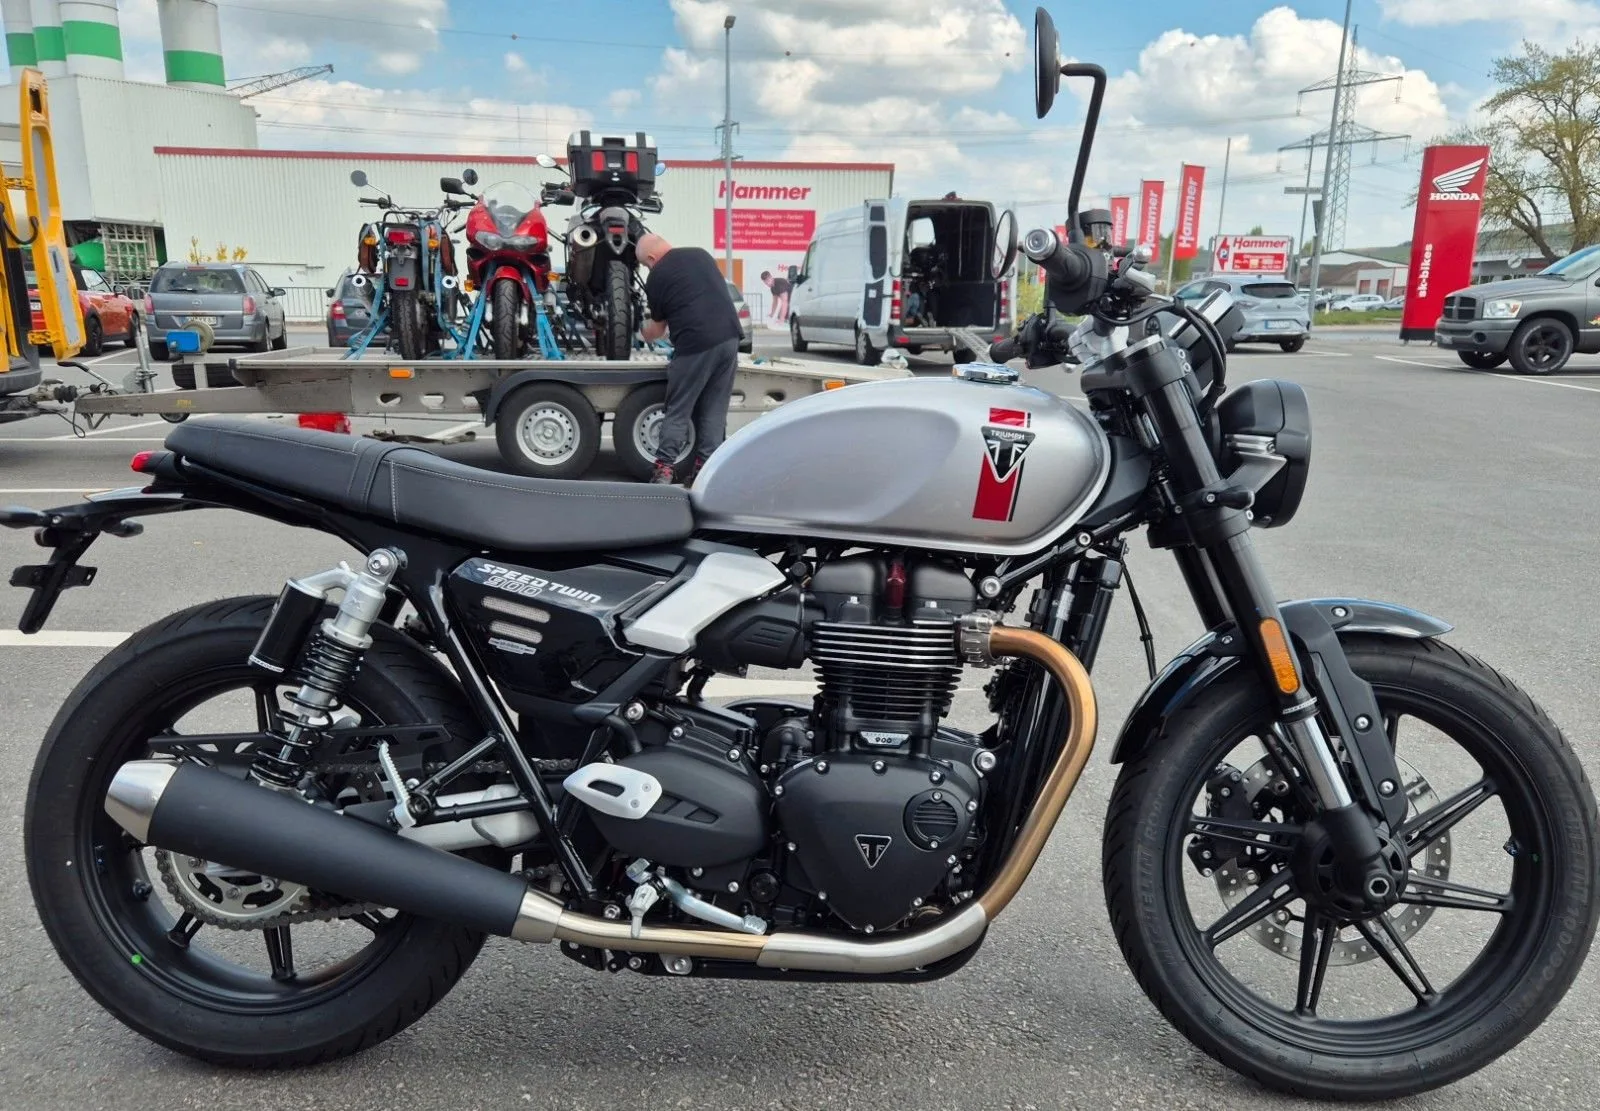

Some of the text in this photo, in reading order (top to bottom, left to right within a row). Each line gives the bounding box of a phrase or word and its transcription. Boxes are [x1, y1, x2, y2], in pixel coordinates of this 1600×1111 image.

[718, 180, 811, 202] Hammer
[1429, 192, 1481, 201] HONDA
[1178, 177, 1199, 249] Hammer
[1232, 237, 1287, 249] Hammer
[1417, 243, 1433, 298] sk-bikes
[990, 429, 1025, 441] TRIUMPH
[476, 563, 602, 604] SPEED TWIN
[483, 575, 543, 598] 900
[875, 736, 892, 744] 900
